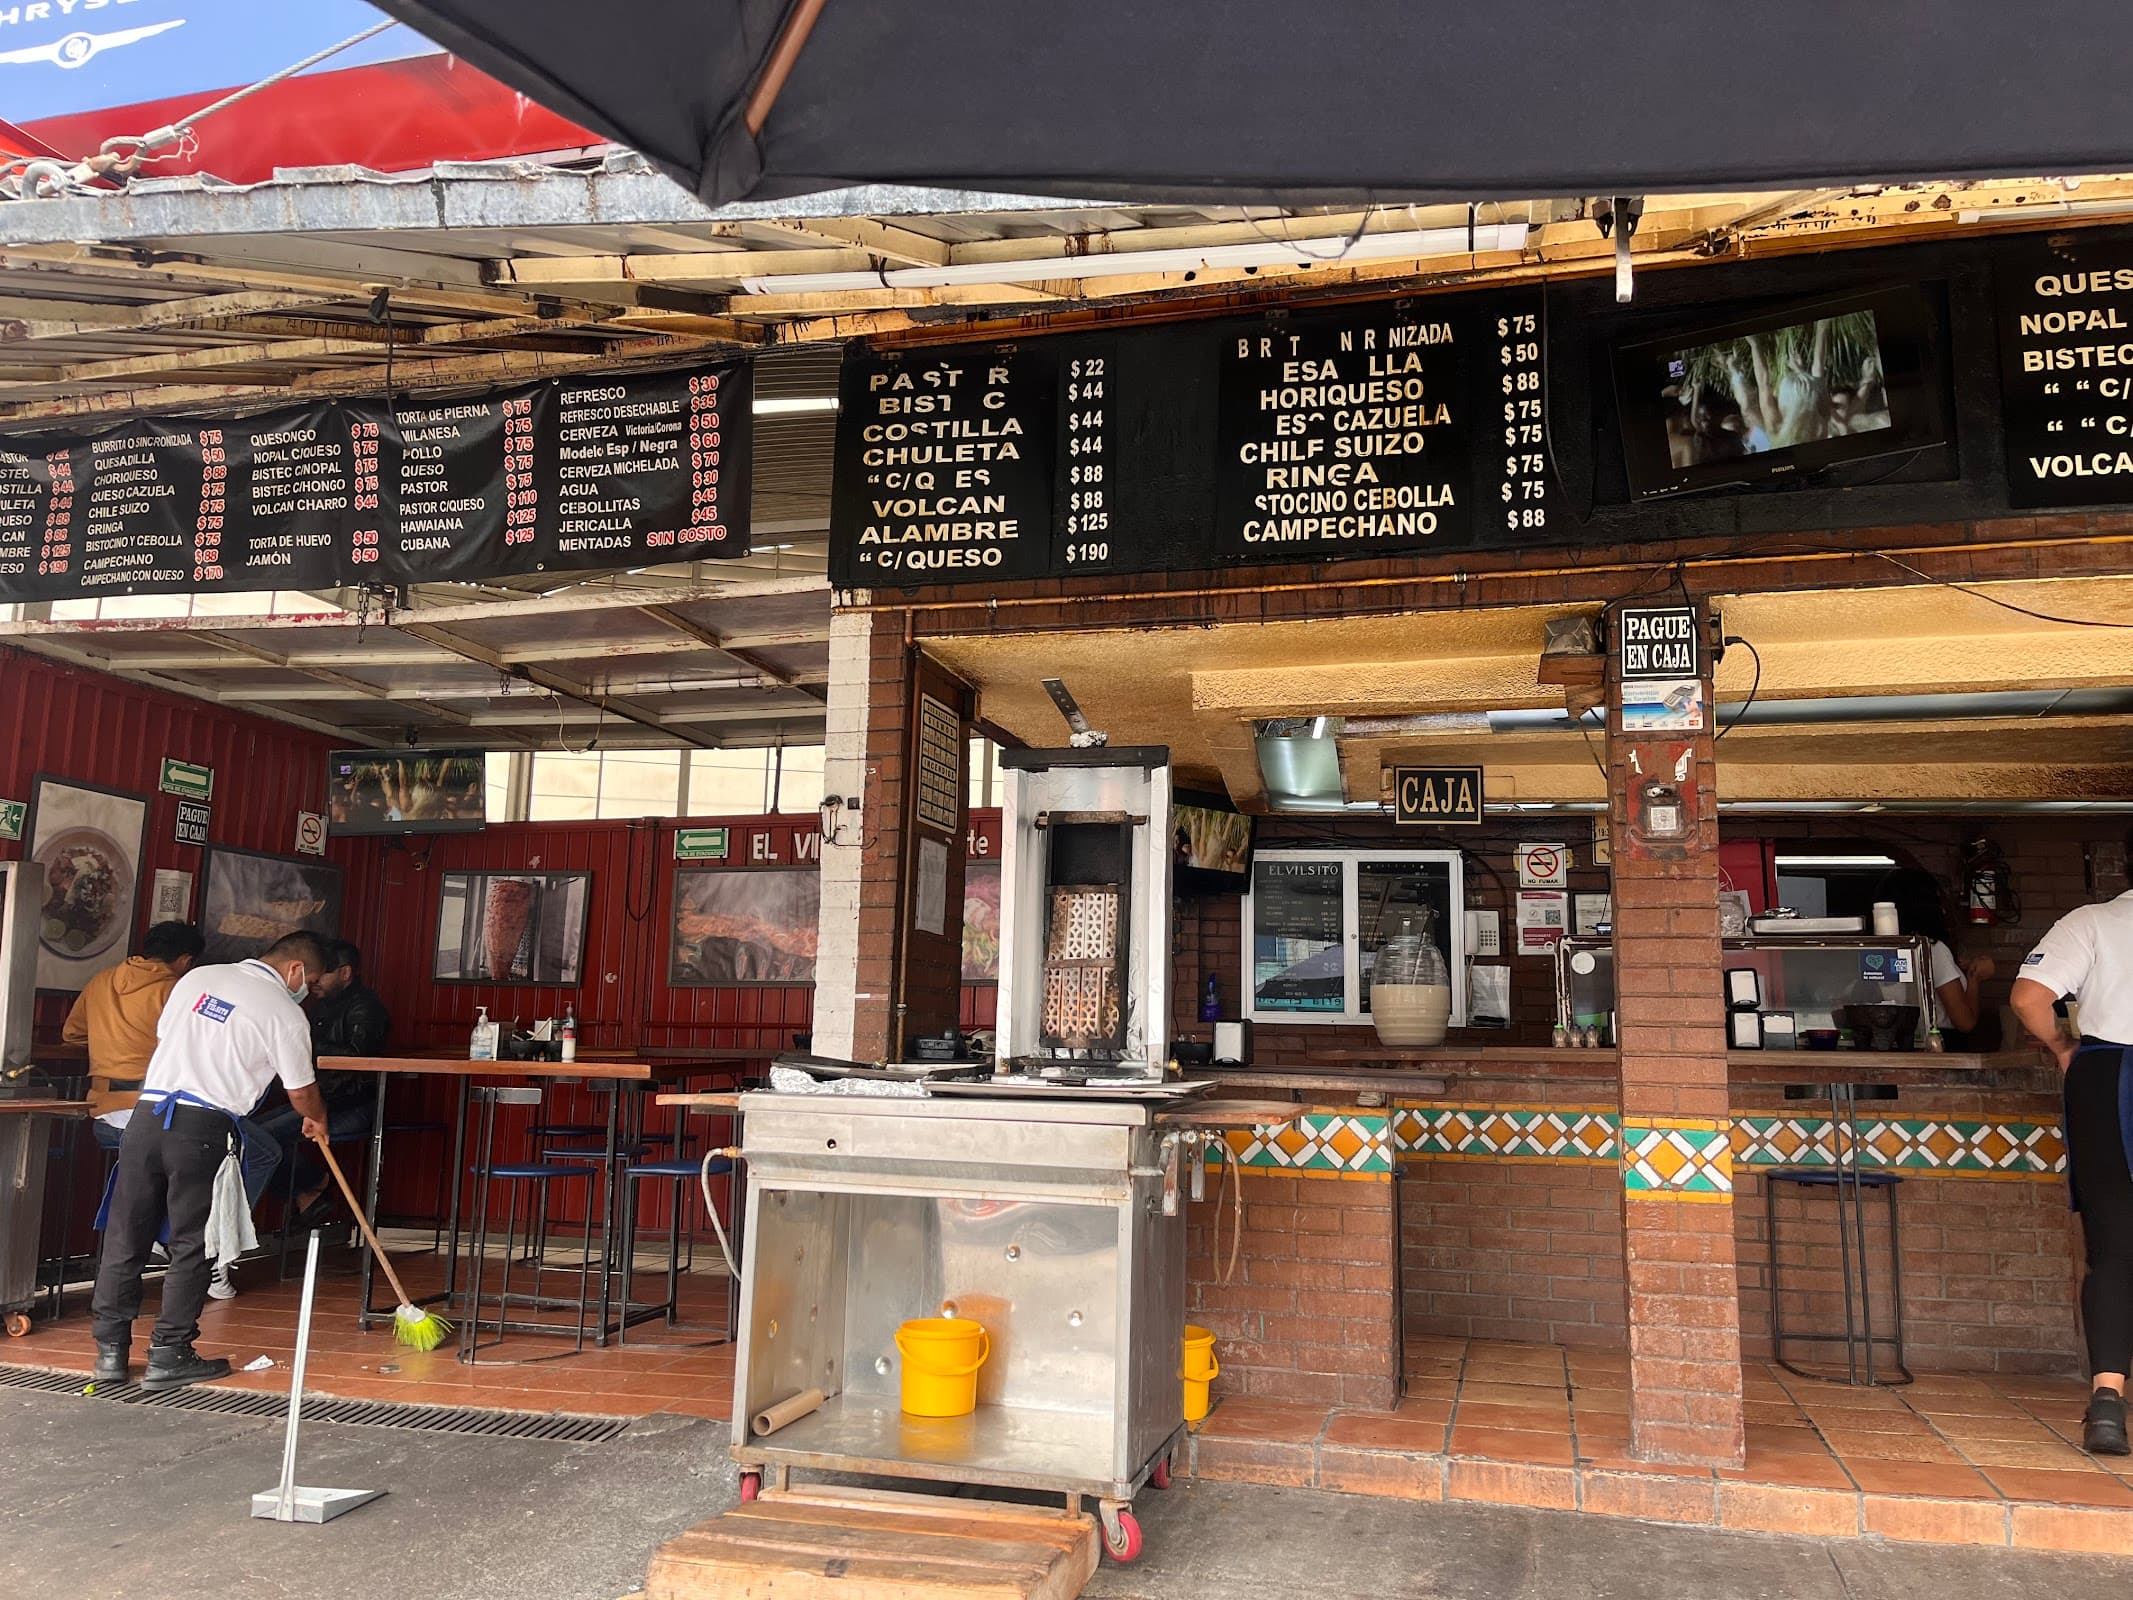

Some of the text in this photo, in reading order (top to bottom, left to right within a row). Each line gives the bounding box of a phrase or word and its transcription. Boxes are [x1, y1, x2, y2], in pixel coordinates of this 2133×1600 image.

[2020, 308, 2127, 335] NOPAL
[1389, 322, 1453, 347] NIZADA
[2023, 344, 2133, 372] BISTEC
[560, 387, 626, 405] REFRESCO
[1260, 378, 1424, 411] HORIQUESO
[396, 410, 428, 425] TORTA
[428, 408, 444, 421] DE
[445, 404, 490, 420] PIERNA
[560, 405, 612, 424] REFRESCO
[613, 400, 680, 420] DESECHABLE
[1334, 403, 1451, 432] CAZUELA
[250, 430, 317, 447] QUESONGO
[400, 426, 461, 442] MILANESA
[560, 426, 618, 441] CERVEZA
[625, 421, 682, 436] Victoria/Corona
[863, 417, 1024, 443] COSTILLA
[91, 440, 126, 454] BURRITA
[135, 433, 193, 448] SINCRONIZADA
[402, 446, 442, 460] POLLO
[560, 446, 604, 460] Modelo
[606, 443, 629, 458] Esp
[640, 438, 678, 454] Negra
[1334, 432, 1424, 458] SUIZO
[94, 453, 155, 471] QUESADILLA
[254, 450, 289, 464] NOPAL
[291, 444, 341, 460] C/QUESO
[863, 442, 1020, 467] CHULETA
[94, 469, 158, 487] CHORIQUESO
[252, 466, 292, 481] BISTEC
[294, 462, 342, 476] C/NOPAL
[401, 463, 445, 478] QUESO
[560, 463, 612, 479] CERVEZA
[613, 457, 679, 474] MICHELADA
[90, 484, 175, 503] QUESO CAZUELA
[252, 484, 292, 499] BISTEC
[292, 479, 346, 495] C/HONGO
[400, 481, 449, 495] PASTOR
[559, 483, 599, 496] AGUA
[1354, 484, 1455, 511] CEBOLLA
[88, 502, 150, 519] CHILE SUIZO
[251, 501, 296, 517] VOLCAN
[297, 497, 348, 511] CHARRO
[399, 500, 438, 516] PASTOR
[439, 498, 485, 513] C/QUESO
[559, 498, 641, 515] CEBOLLITAS
[872, 495, 1005, 518] VOLCAN
[87, 521, 124, 536] GRINGA
[400, 517, 464, 535] HAWAIANA
[559, 518, 632, 533] JERICALLA
[859, 520, 1019, 545] ALAMBRE
[1243, 512, 1437, 542] CAMPECHANO
[137, 534, 183, 547] CEBOLLA
[248, 537, 279, 551] TORTA
[280, 536, 294, 548] DE
[296, 534, 332, 548] HUEVO
[400, 537, 451, 552] CUBANA
[559, 525, 727, 552] MENTADAS SIN COSTO
[84, 554, 154, 570] CAMPECHANO
[246, 552, 291, 567] JAMÓN
[81, 569, 184, 587] CAMPECHANO CON QUESO
[1626, 615, 1690, 640] PAGUE
[1626, 643, 1691, 670] EN CAJA
[1401, 776, 1475, 813] CAJA
[180, 807, 208, 824] PAGUE
[177, 822, 206, 841] EN CAJA
[752, 832, 778, 860] EL
